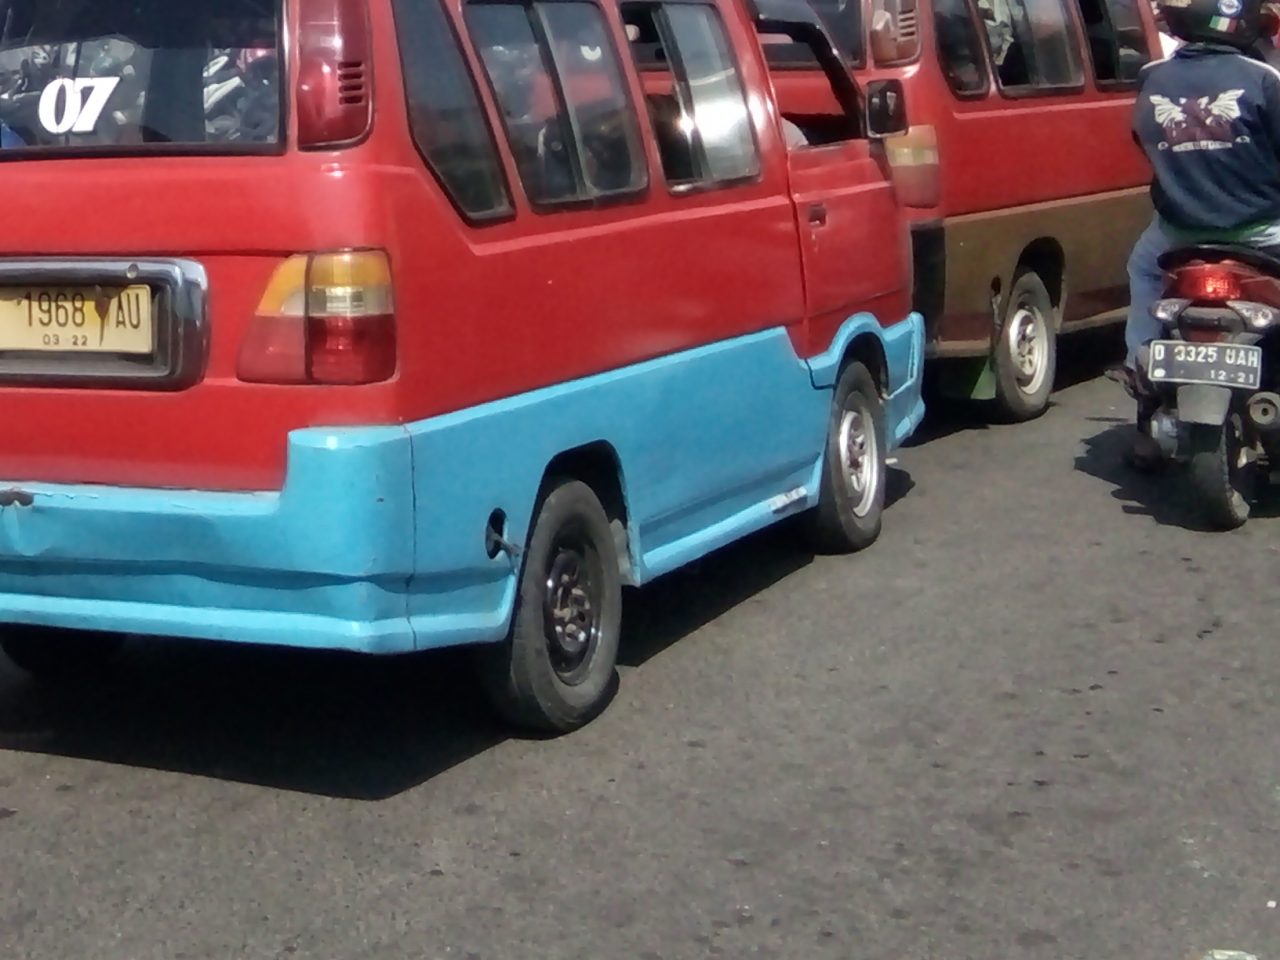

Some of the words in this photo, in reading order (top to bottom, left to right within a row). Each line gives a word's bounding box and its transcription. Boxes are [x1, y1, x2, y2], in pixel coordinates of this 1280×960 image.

[38, 76, 120, 135] 07
[25, 292, 86, 329] 1968
[115, 291, 141, 329] AU
[1154, 345, 1165, 361] D
[1174, 346, 1218, 363] 3325
[1225, 348, 1258, 368] UAH
